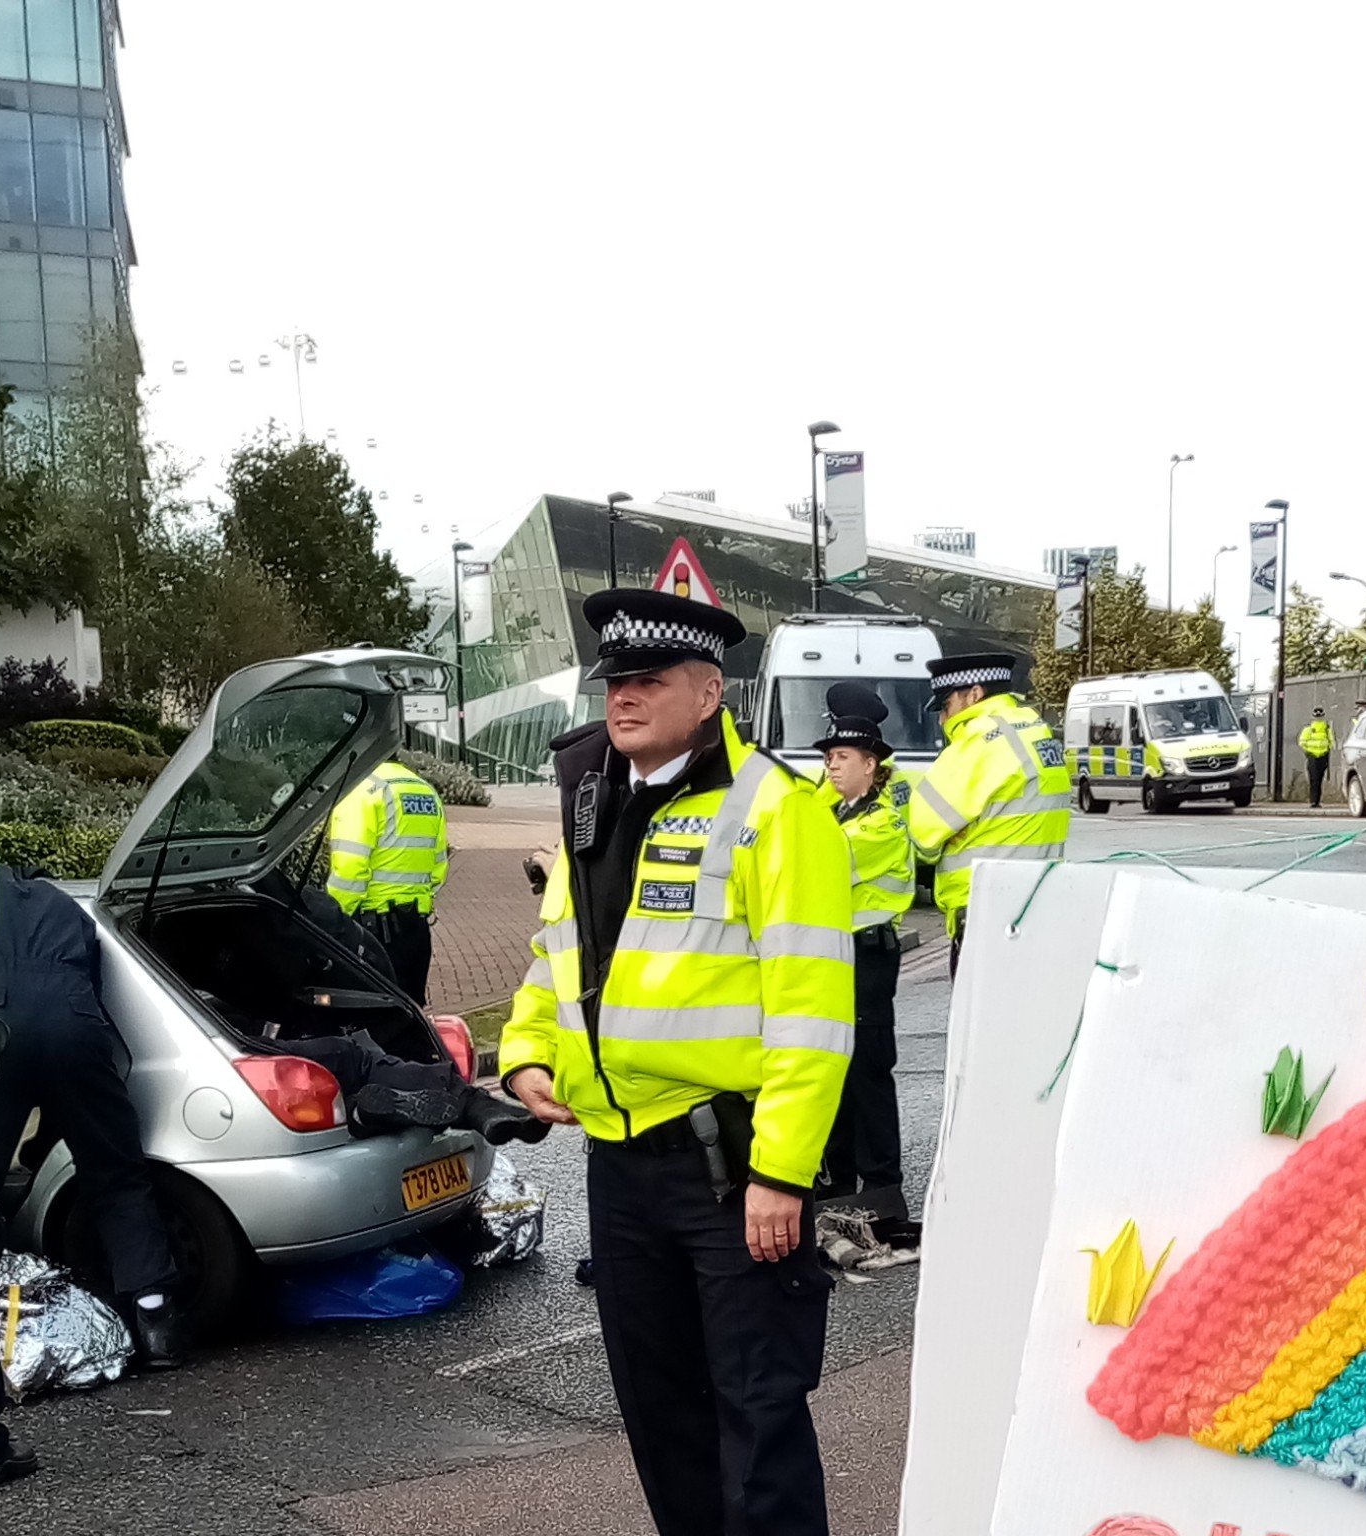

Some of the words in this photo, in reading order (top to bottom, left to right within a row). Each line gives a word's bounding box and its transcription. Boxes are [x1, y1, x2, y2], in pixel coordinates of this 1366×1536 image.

[826, 455, 858, 468] Crystal
[403, 801, 437, 813] POLICE
[402, 1167, 440, 1204] T378
